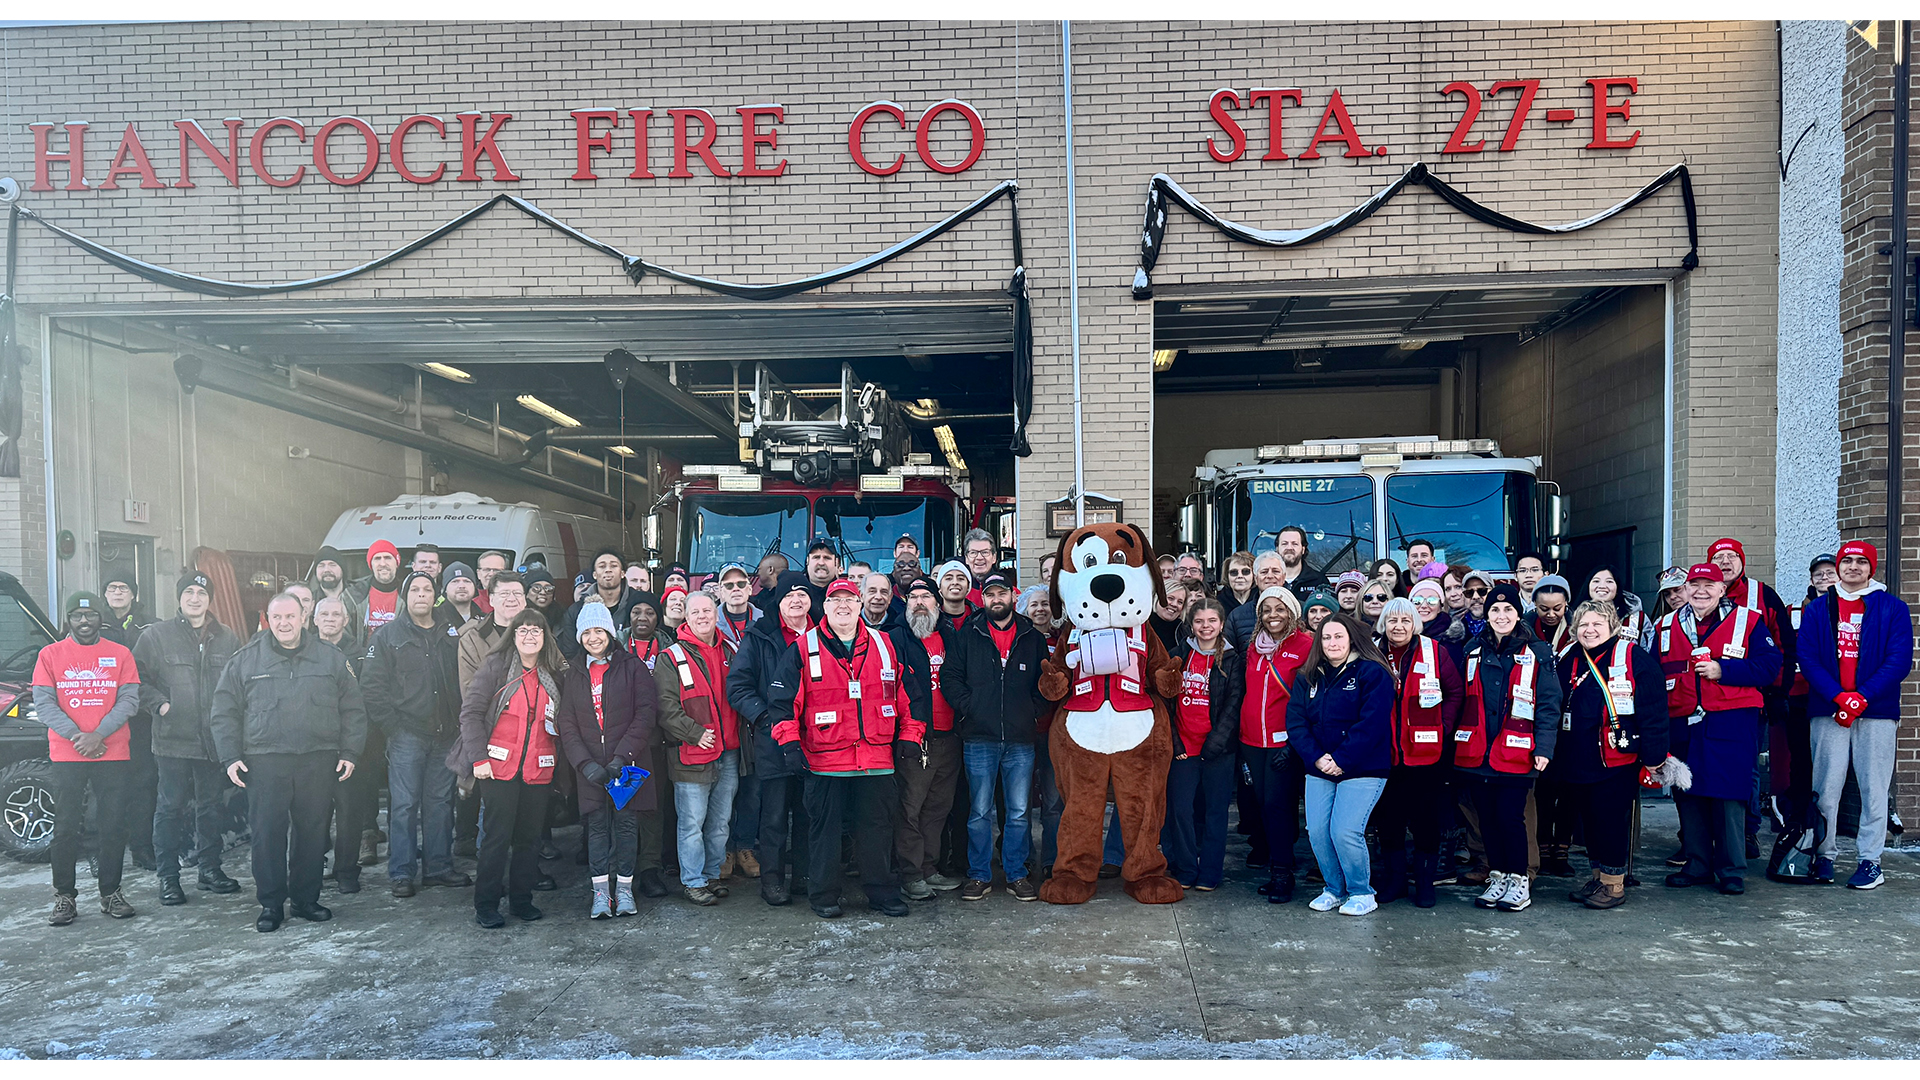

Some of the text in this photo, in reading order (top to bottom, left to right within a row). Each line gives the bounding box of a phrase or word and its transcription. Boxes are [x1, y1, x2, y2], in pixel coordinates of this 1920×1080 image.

[1206, 77, 1641, 163] STA. 27-E
[30, 99, 986, 192] HANCOCK FIRE CO
[1253, 479, 1335, 494] ENGINE 27
[132, 500, 148, 521] EXIT
[56, 681, 80, 689] SOUND
[92, 680, 117, 688] ALARM
